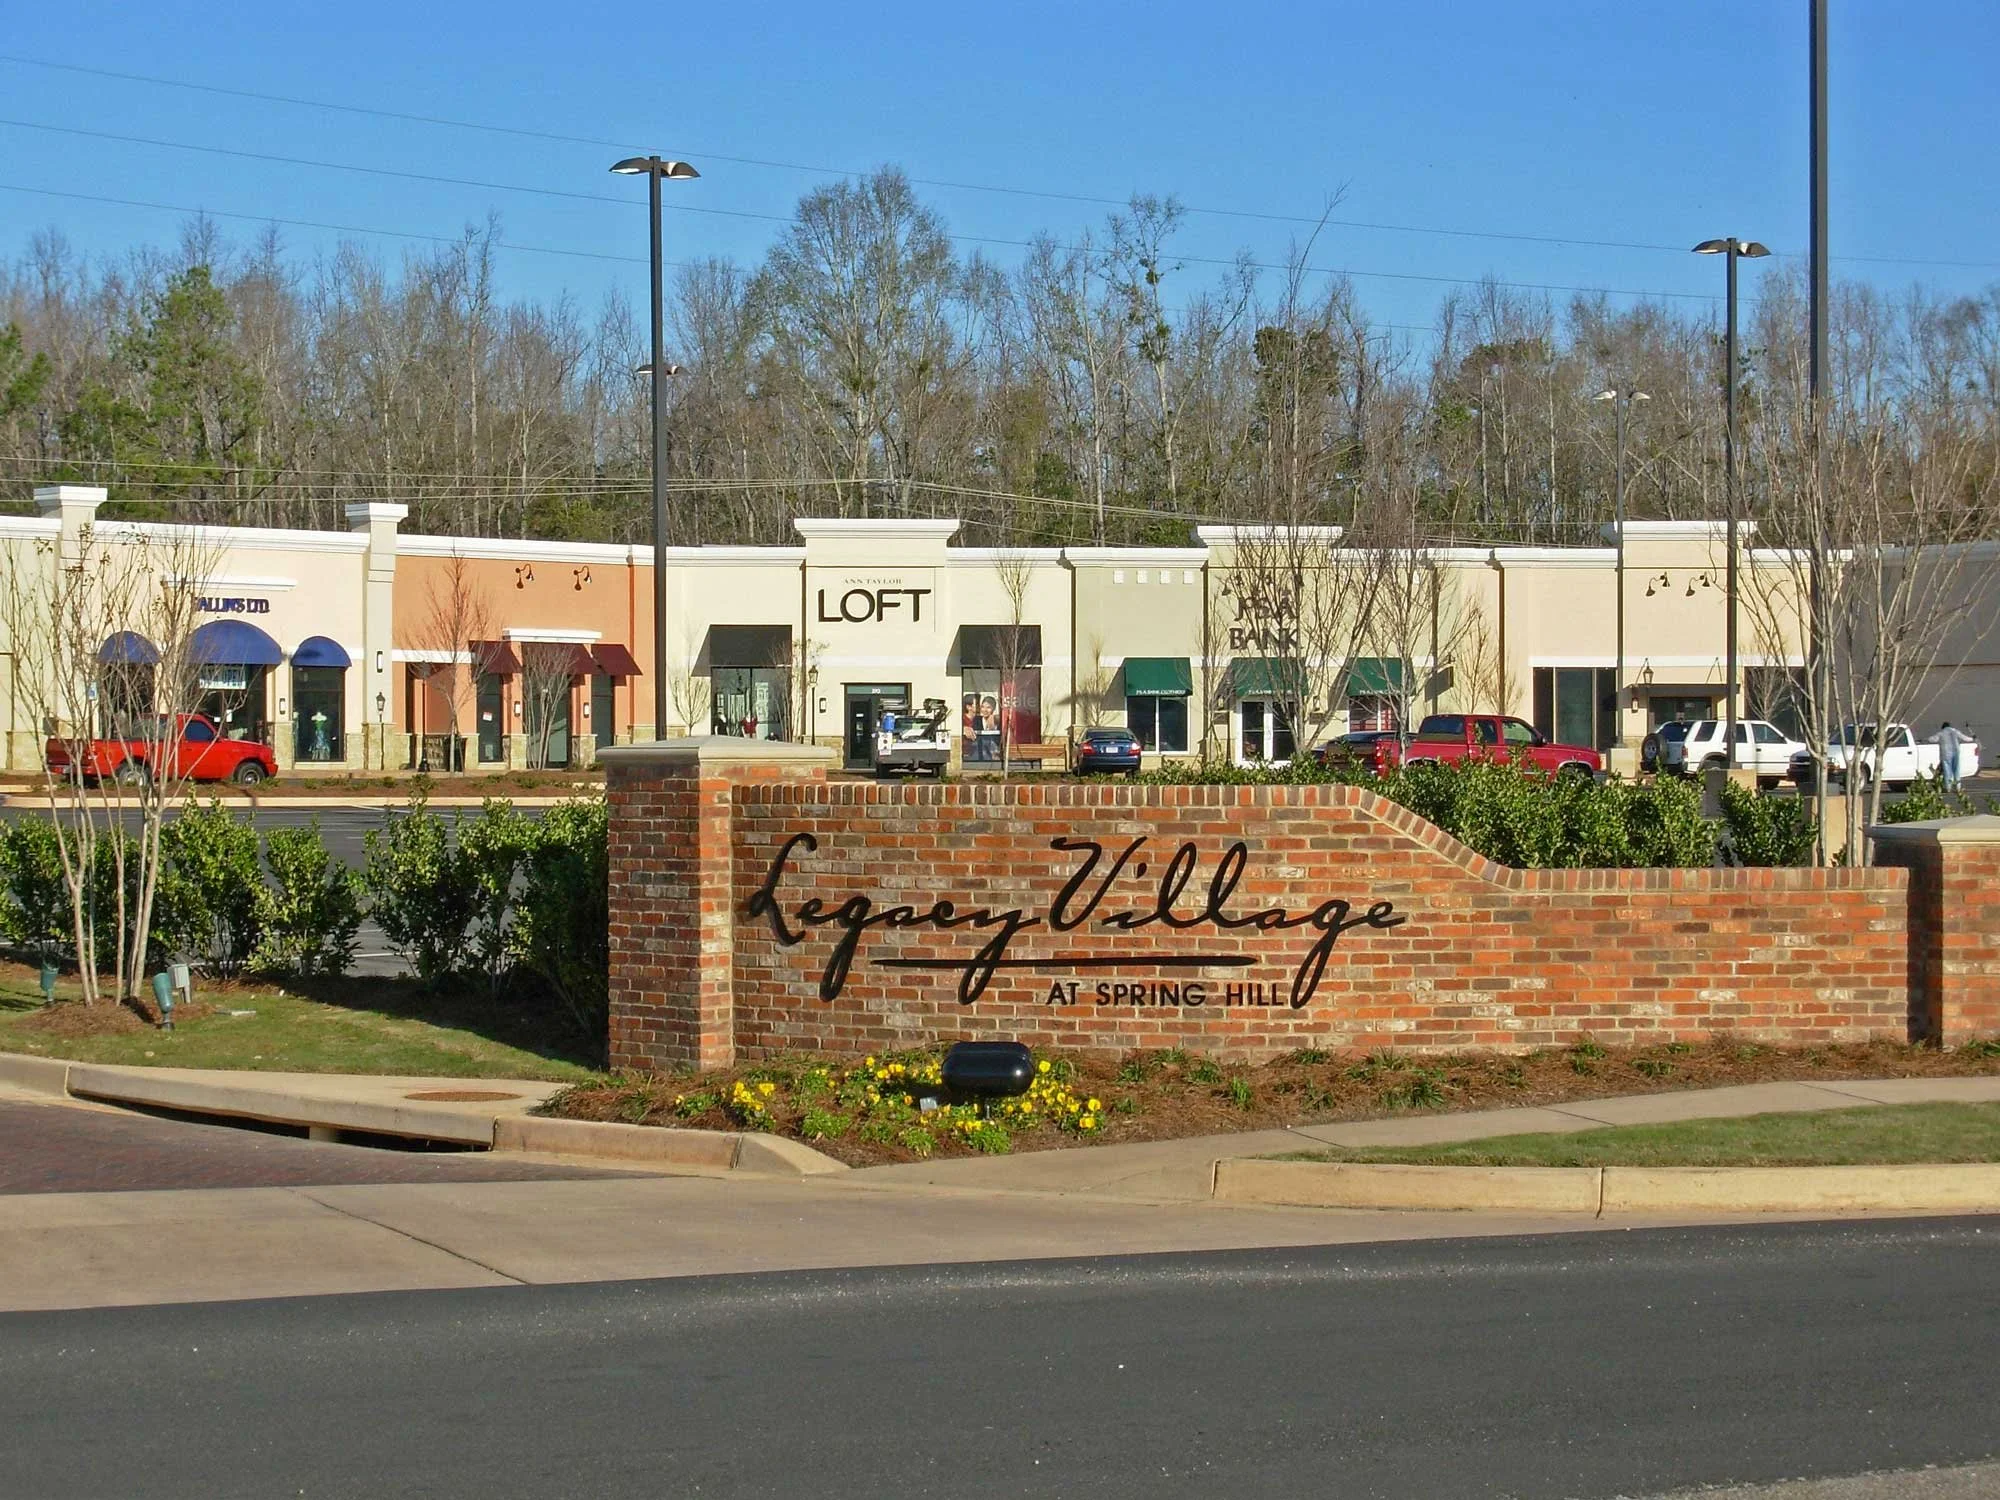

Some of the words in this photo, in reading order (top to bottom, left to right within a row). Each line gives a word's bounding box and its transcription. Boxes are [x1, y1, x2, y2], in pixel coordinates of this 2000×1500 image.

[818, 588, 932, 622] LOFT
[1229, 627, 1304, 650] BANK
[1003, 691, 1037, 708] sale
[750, 832, 1041, 1006] Legacy
[1049, 835, 1406, 1010] Village
[1045, 982, 1080, 1006] AT
[1096, 982, 1206, 1007] SPRING
[1226, 983, 1285, 1007] HILL
